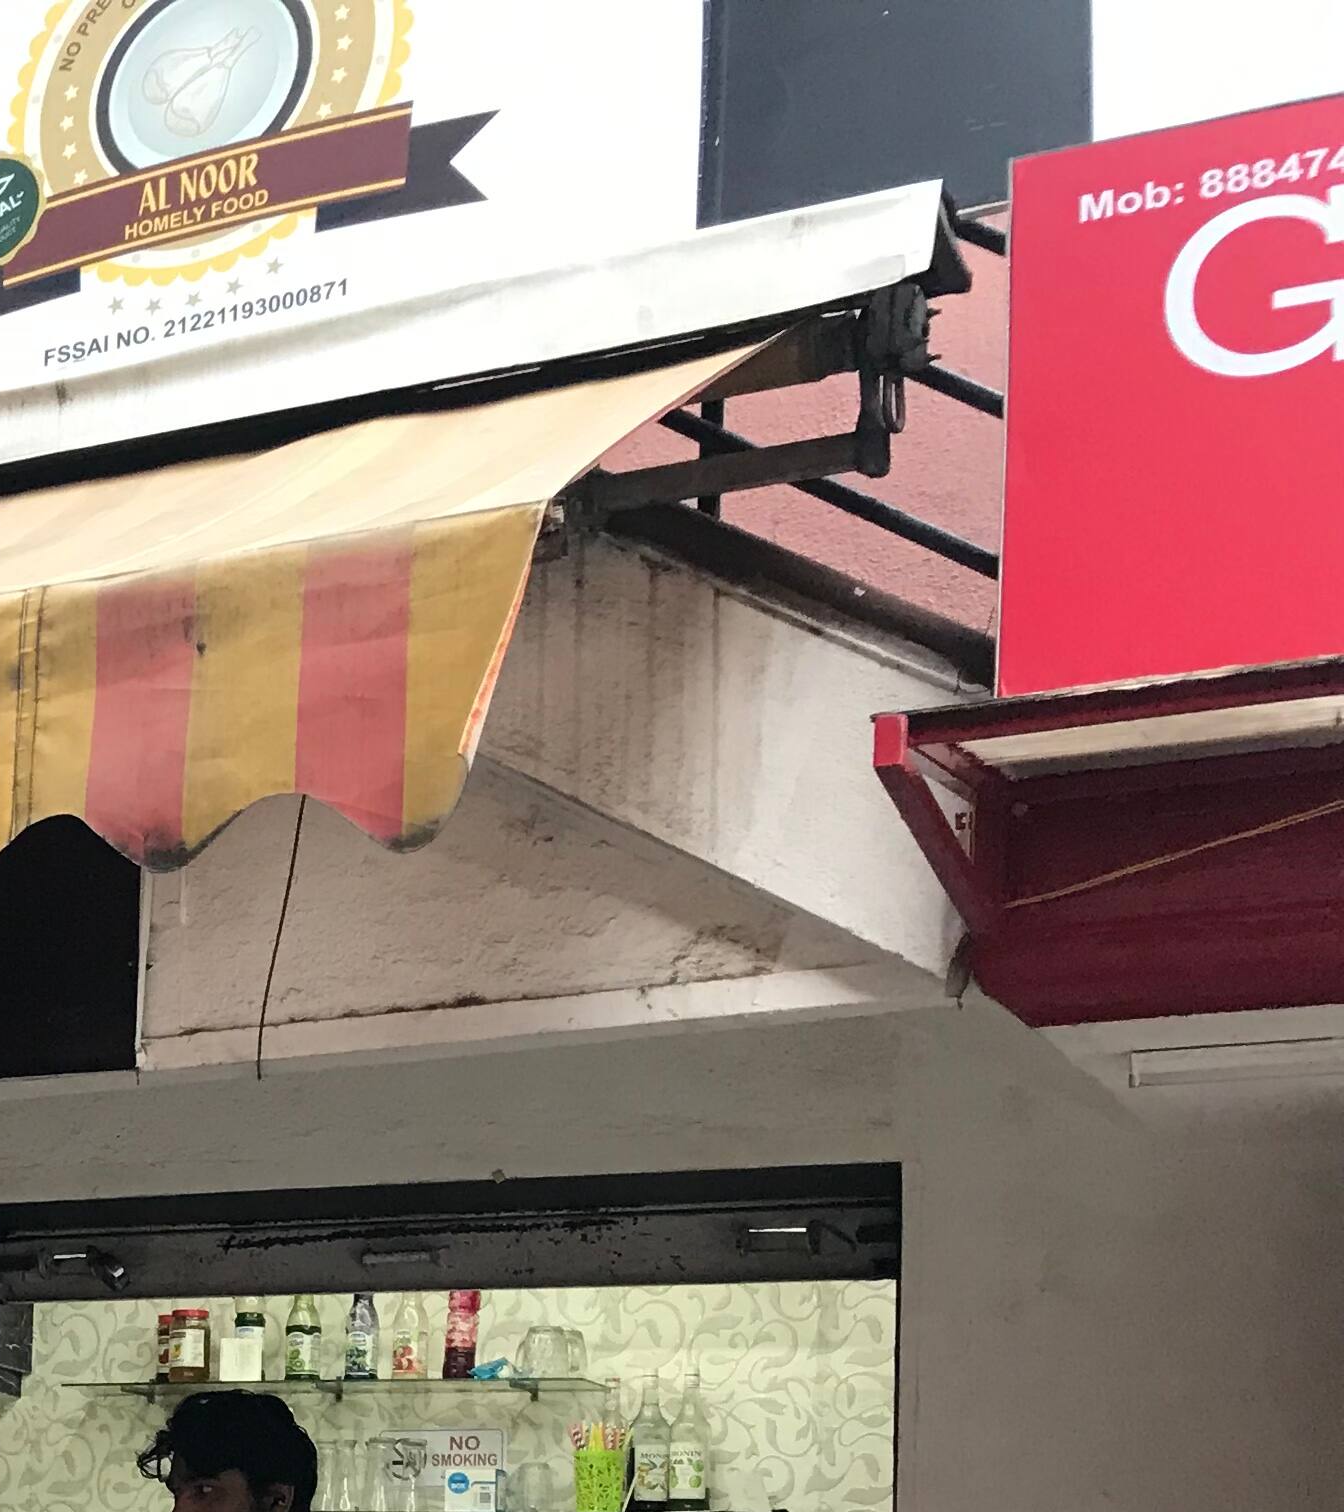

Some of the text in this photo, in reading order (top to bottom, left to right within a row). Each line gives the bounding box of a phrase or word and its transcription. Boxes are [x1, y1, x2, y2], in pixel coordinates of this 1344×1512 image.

[138, 152, 260, 217] AL NOOR
[1078, 182, 1185, 224] Mob:
[124, 189, 270, 241] HOMELY FOOD
[43, 278, 349, 367] FSSAI NO. 21221193000871
[431, 1453, 499, 1468] SMOKING
[449, 1435, 481, 1451] NO
